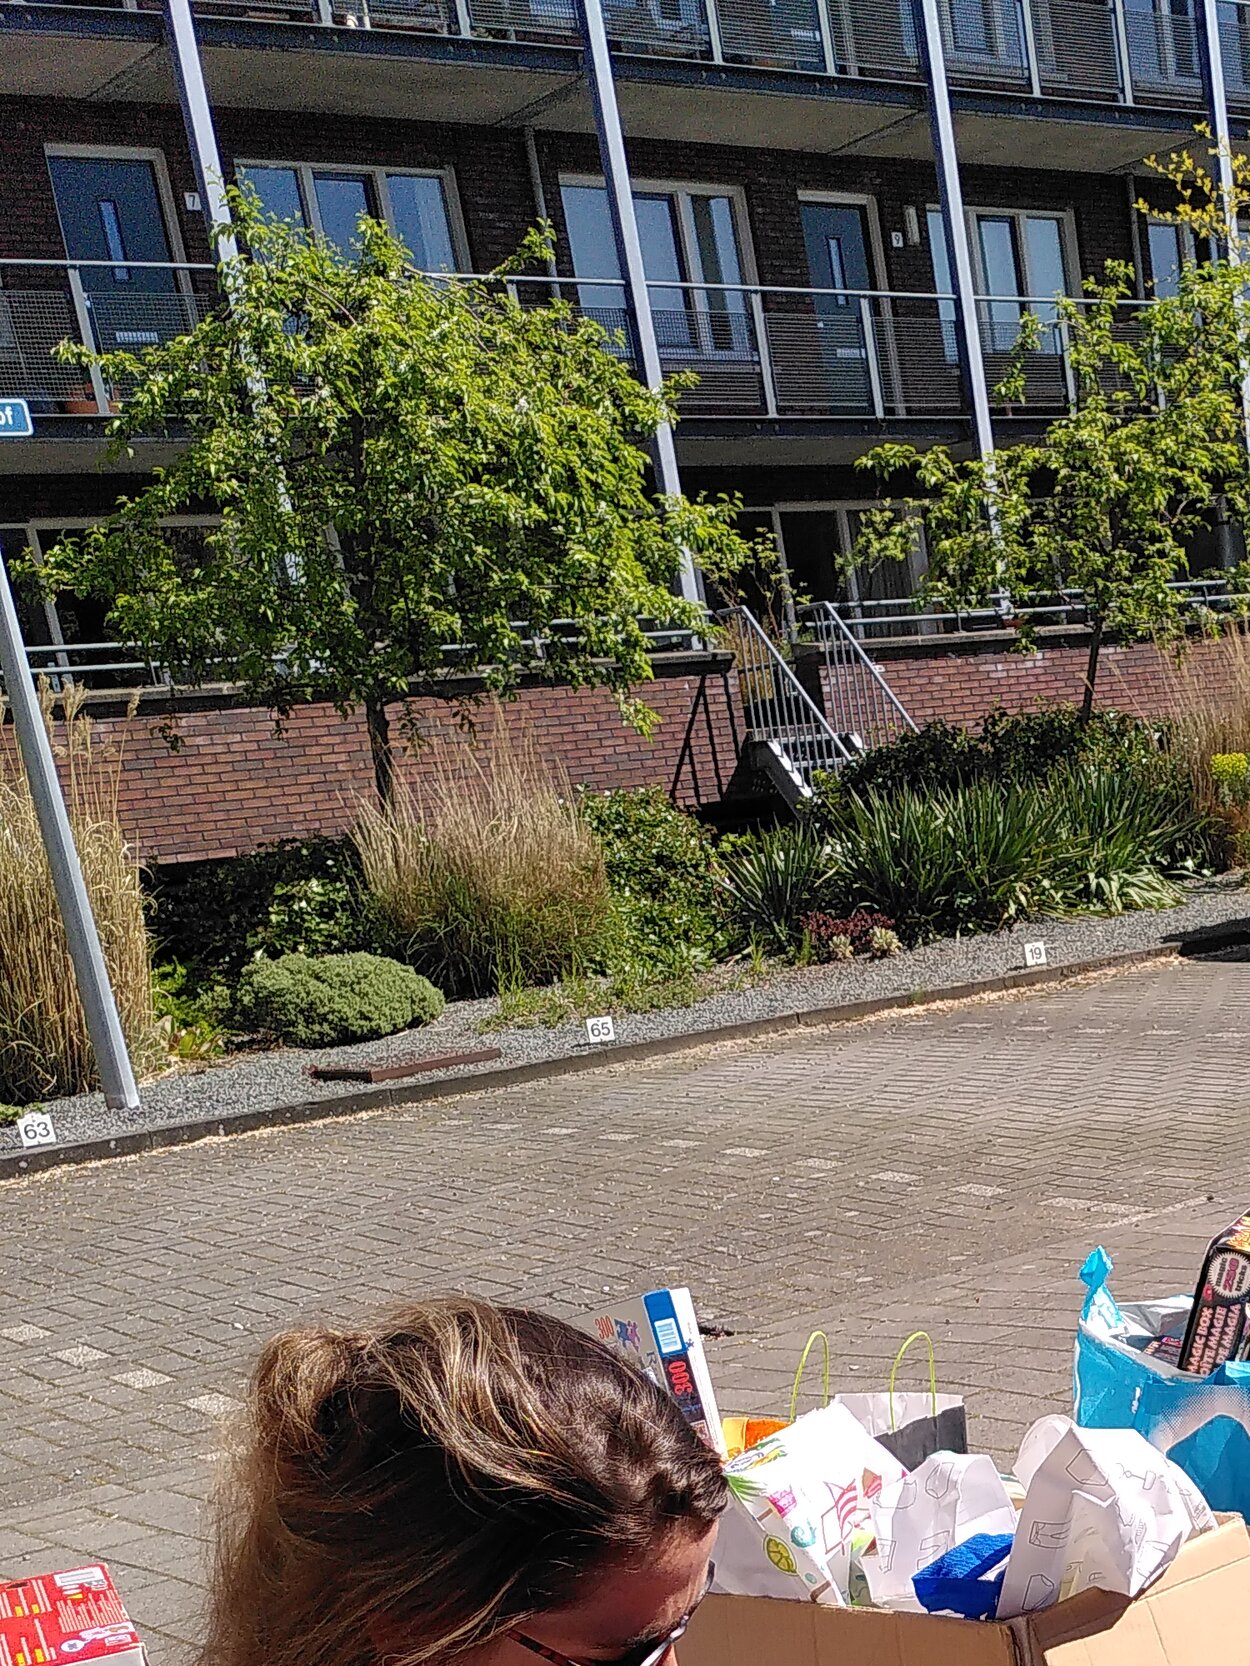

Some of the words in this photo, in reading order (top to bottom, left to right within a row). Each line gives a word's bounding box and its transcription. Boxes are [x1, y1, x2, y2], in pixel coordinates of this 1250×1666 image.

[591, 1022, 610, 1037] 65
[24, 1122, 50, 1139] 63
[1213, 1256, 1228, 1286] magic
[1221, 1256, 1240, 1292] 250
[1234, 1264, 1248, 1292] tricks
[595, 1315, 614, 1340] 300
[1195, 1306, 1214, 1335] BOX
[1206, 1305, 1227, 1348] MAGIE
[1220, 1302, 1242, 1347] MAGIA
[668, 1361, 692, 1395] 300
